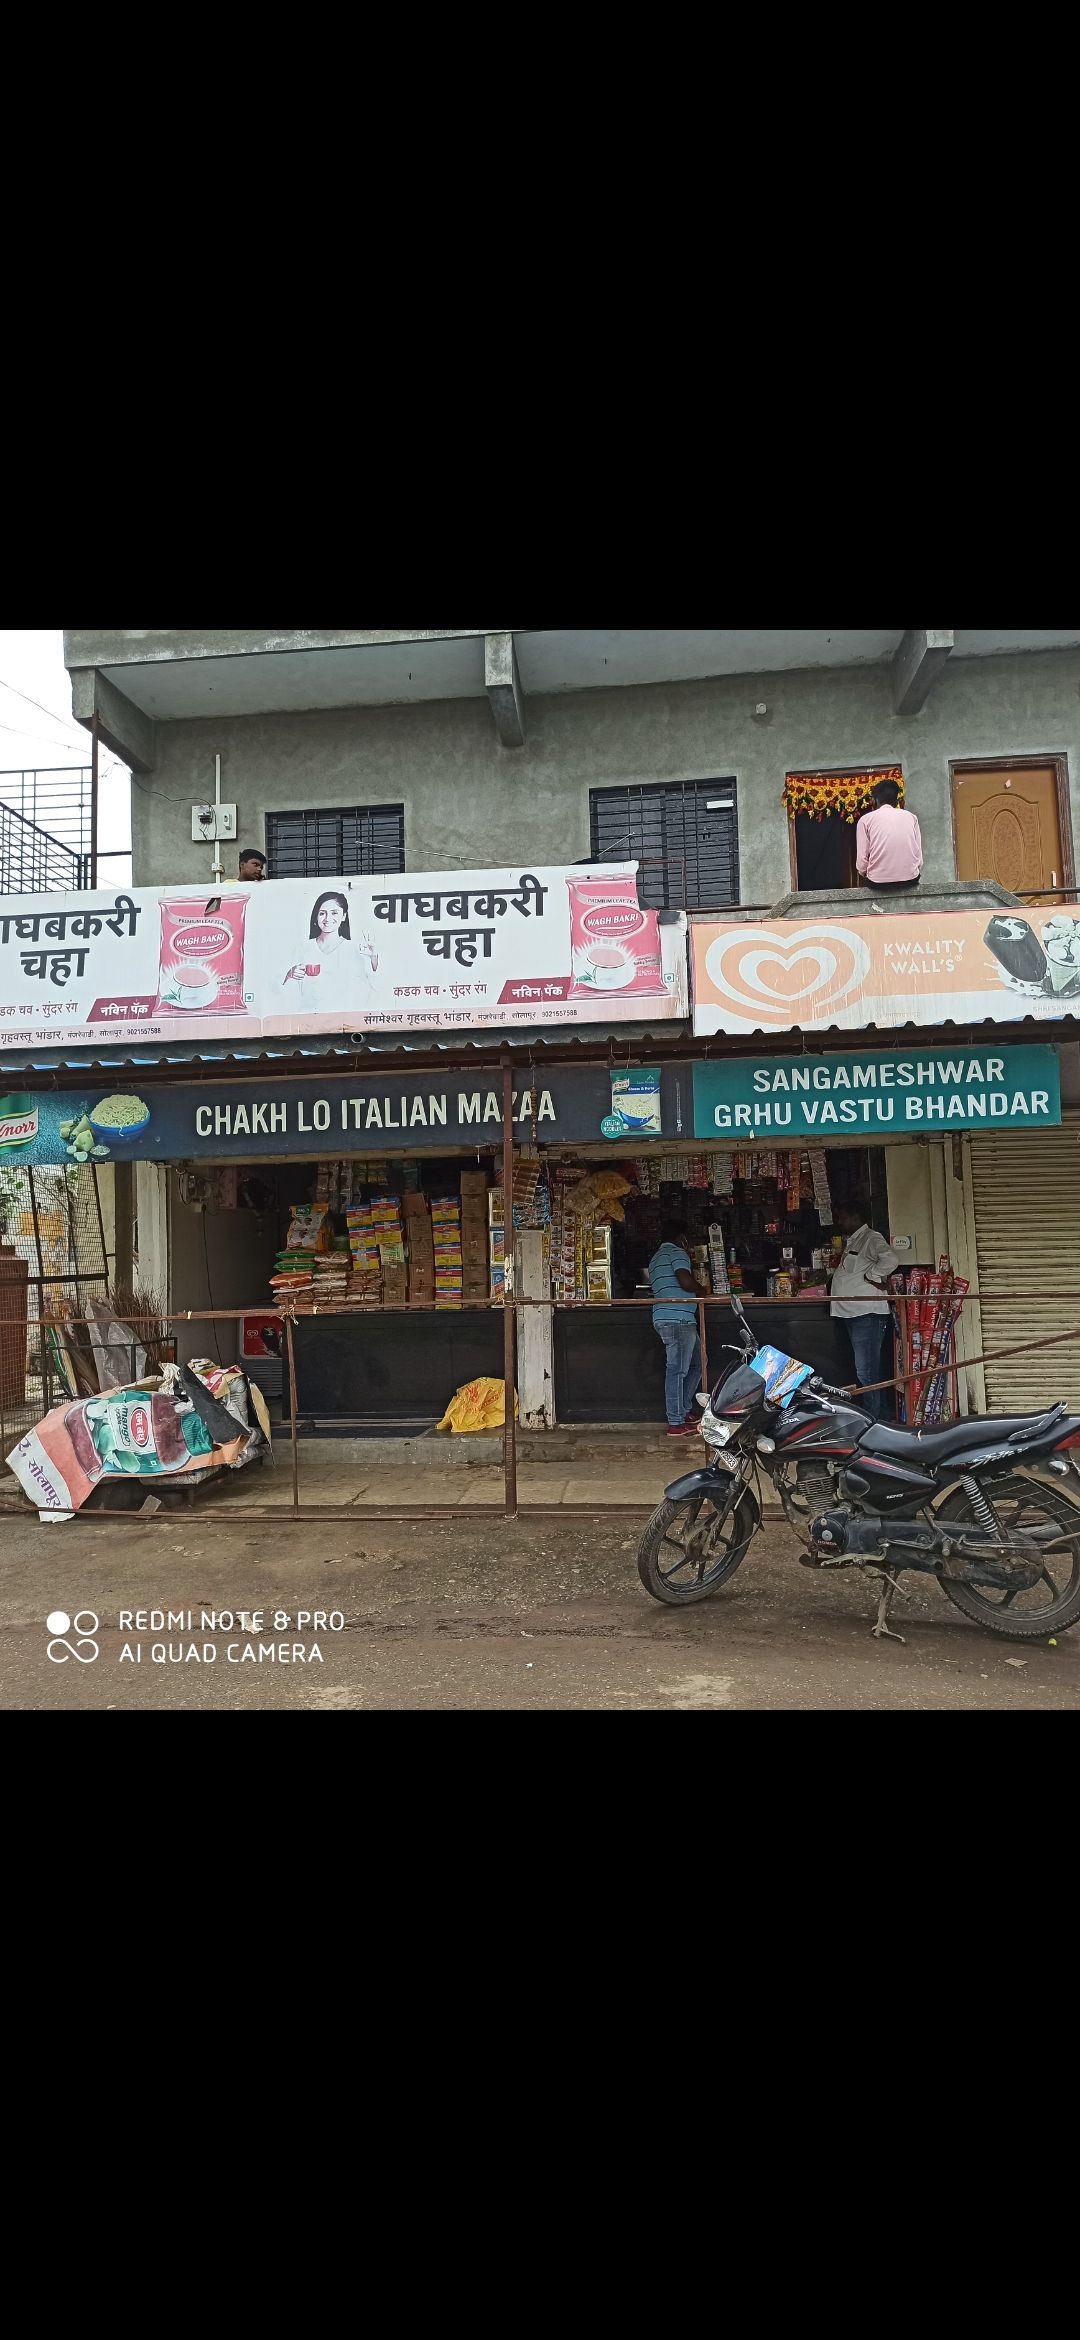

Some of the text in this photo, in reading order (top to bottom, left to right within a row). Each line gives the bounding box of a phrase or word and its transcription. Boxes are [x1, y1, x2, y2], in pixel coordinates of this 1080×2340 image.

[372, 874, 548, 923] वाघबकरी
[0, 895, 141, 943] ाघबकरी
[587, 913, 638, 927] WAGH BAKRI
[176, 933, 225, 947] WAGH BAKRI
[422, 928, 495, 968] चहा
[884, 939, 966, 956] KWALITY
[20, 948, 90, 987] चहा
[393, 980, 488, 999] कडक चव सुंदर रंग
[512, 984, 541, 998] नविन
[0, 1000, 78, 1018] डक चव सुंदर रंग
[100, 1004, 129, 1016] नविन
[363, 1012, 403, 1025] संगमेश्वर
[407, 1013, 442, 1026] गृहवस्तू
[1, 1032, 34, 1044] गृहवस्तू
[753, 1058, 1005, 1093] SANGAMESHWAR
[196, 1102, 287, 1136] CHAKH
[298, 1099, 331, 1132] LO
[341, 1094, 447, 1130] ITALIAN
[714, 1101, 792, 1127] GRHU
[801, 1097, 894, 1124] VASTU
[905, 1090, 1049, 1121] BHANDAR
[121, 1407, 131, 1443] mango
